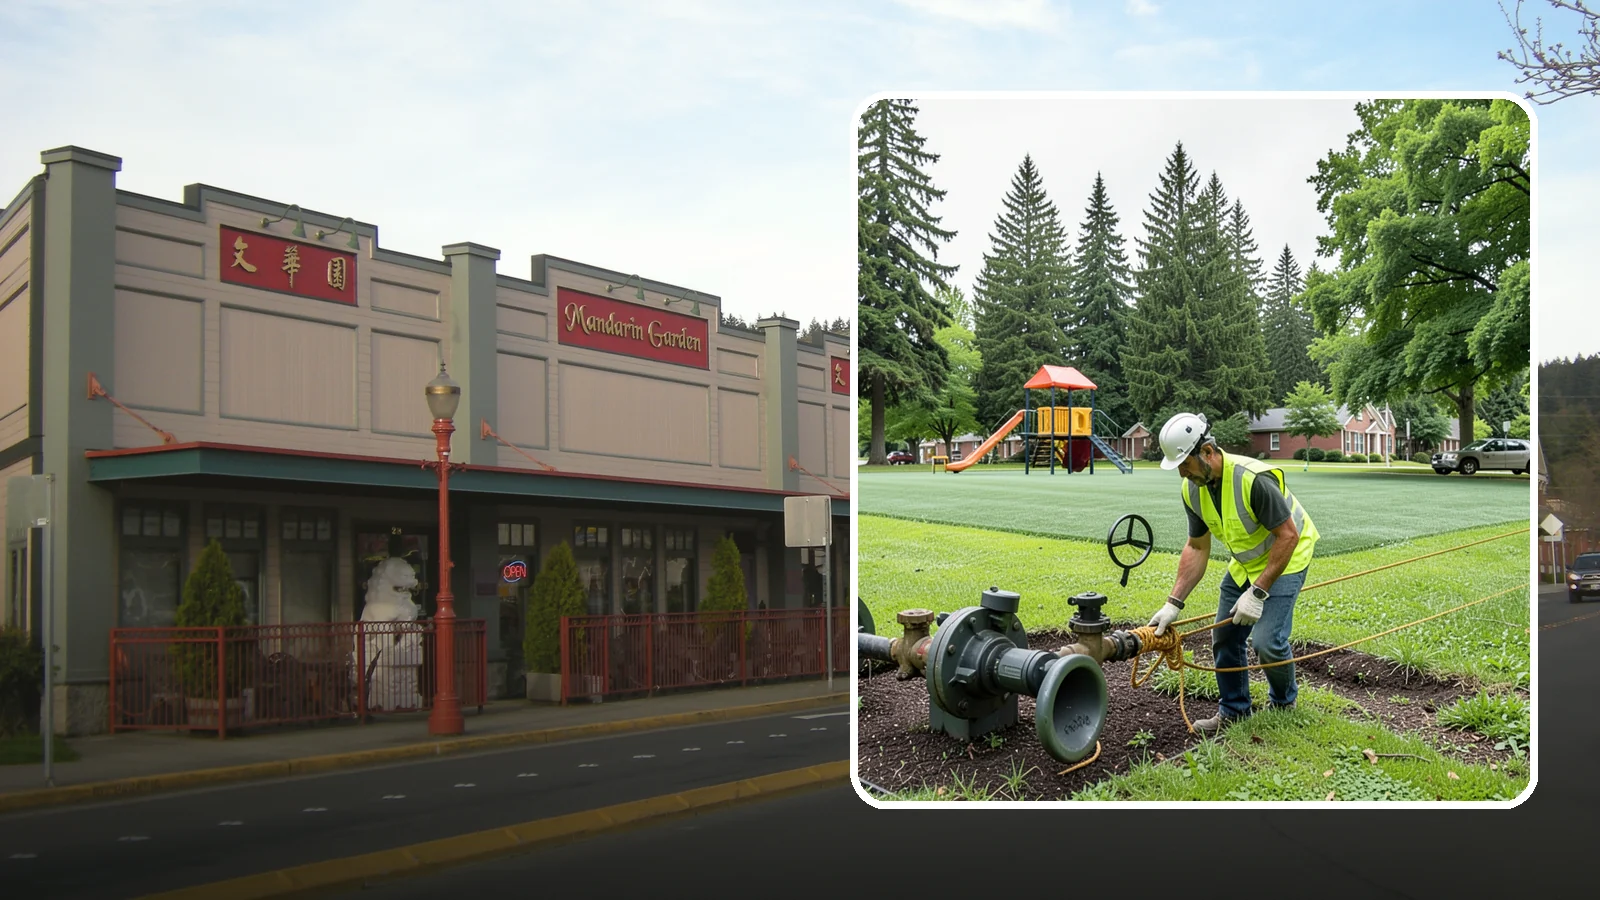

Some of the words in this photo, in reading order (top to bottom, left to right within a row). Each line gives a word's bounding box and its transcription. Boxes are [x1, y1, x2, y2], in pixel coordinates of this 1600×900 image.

[564, 302, 644, 341] Mandarin
[648, 320, 701, 352] Garden
[503, 565, 527, 578] OPEN
